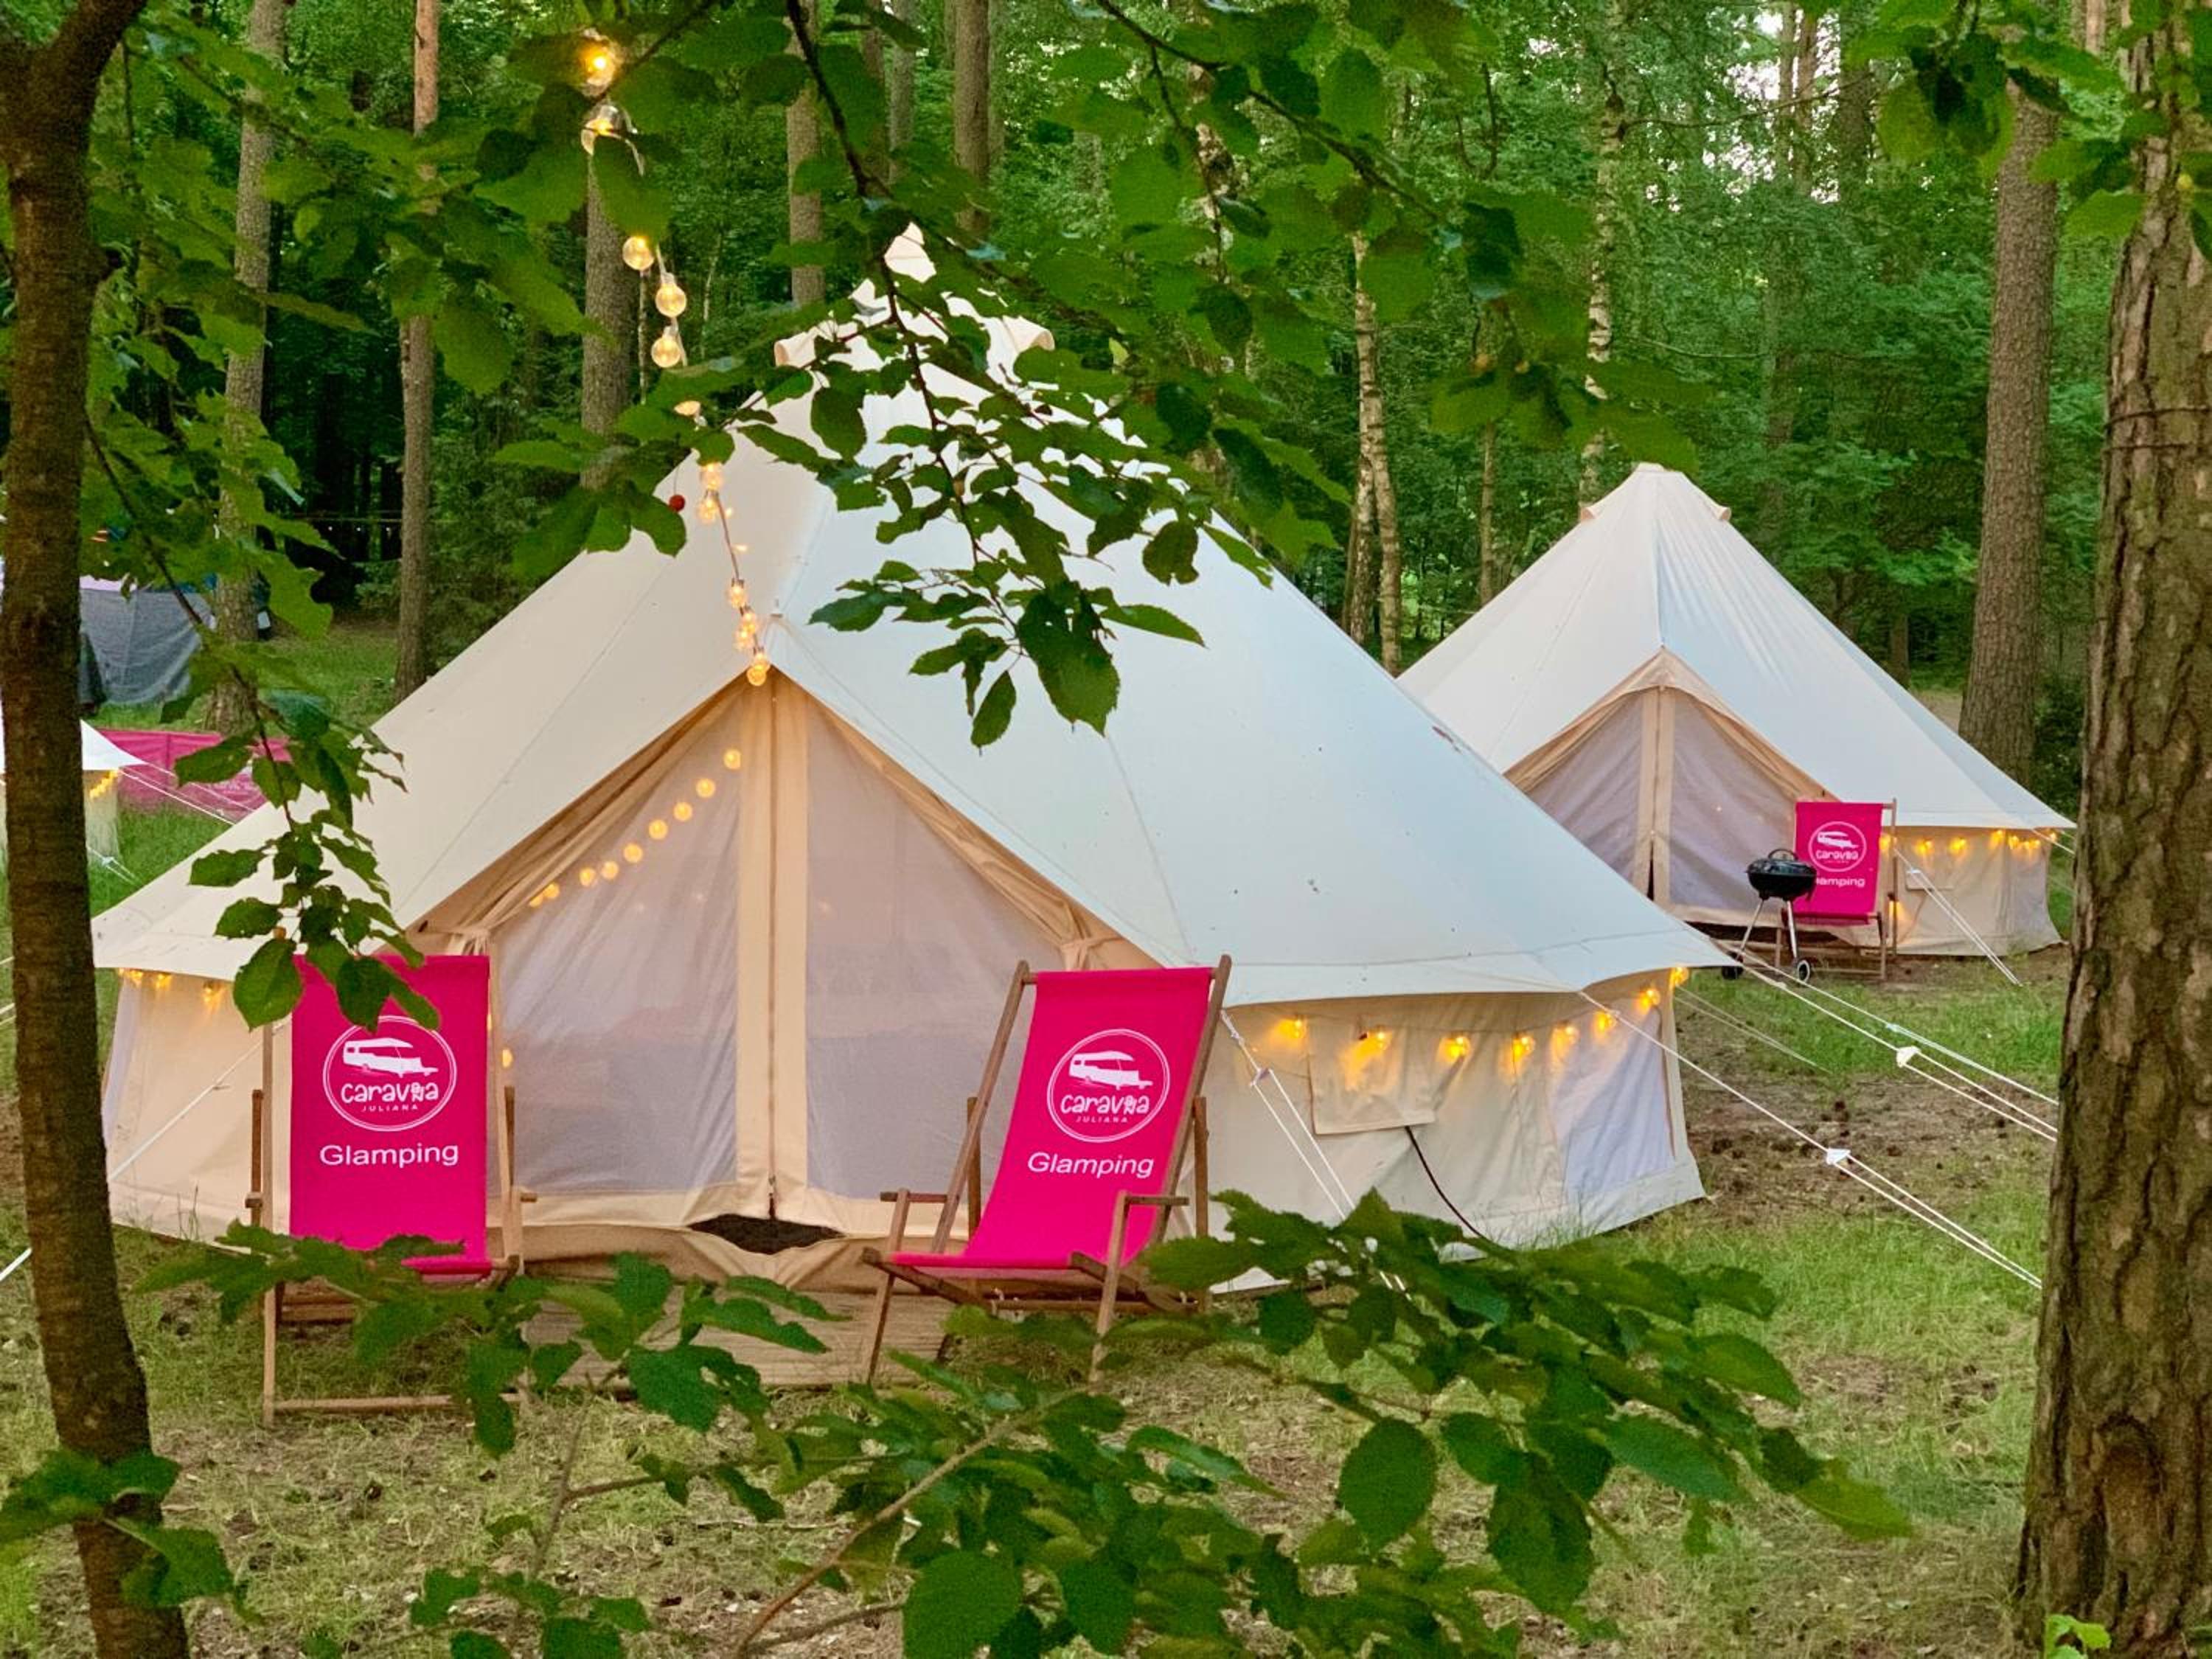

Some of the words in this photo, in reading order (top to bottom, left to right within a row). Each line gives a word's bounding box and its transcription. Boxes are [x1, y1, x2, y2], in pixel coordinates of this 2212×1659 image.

[1815, 876, 1865, 888] lamping
[319, 1142, 459, 1168] Glamping
[1027, 1152, 1155, 1178] Glamping
